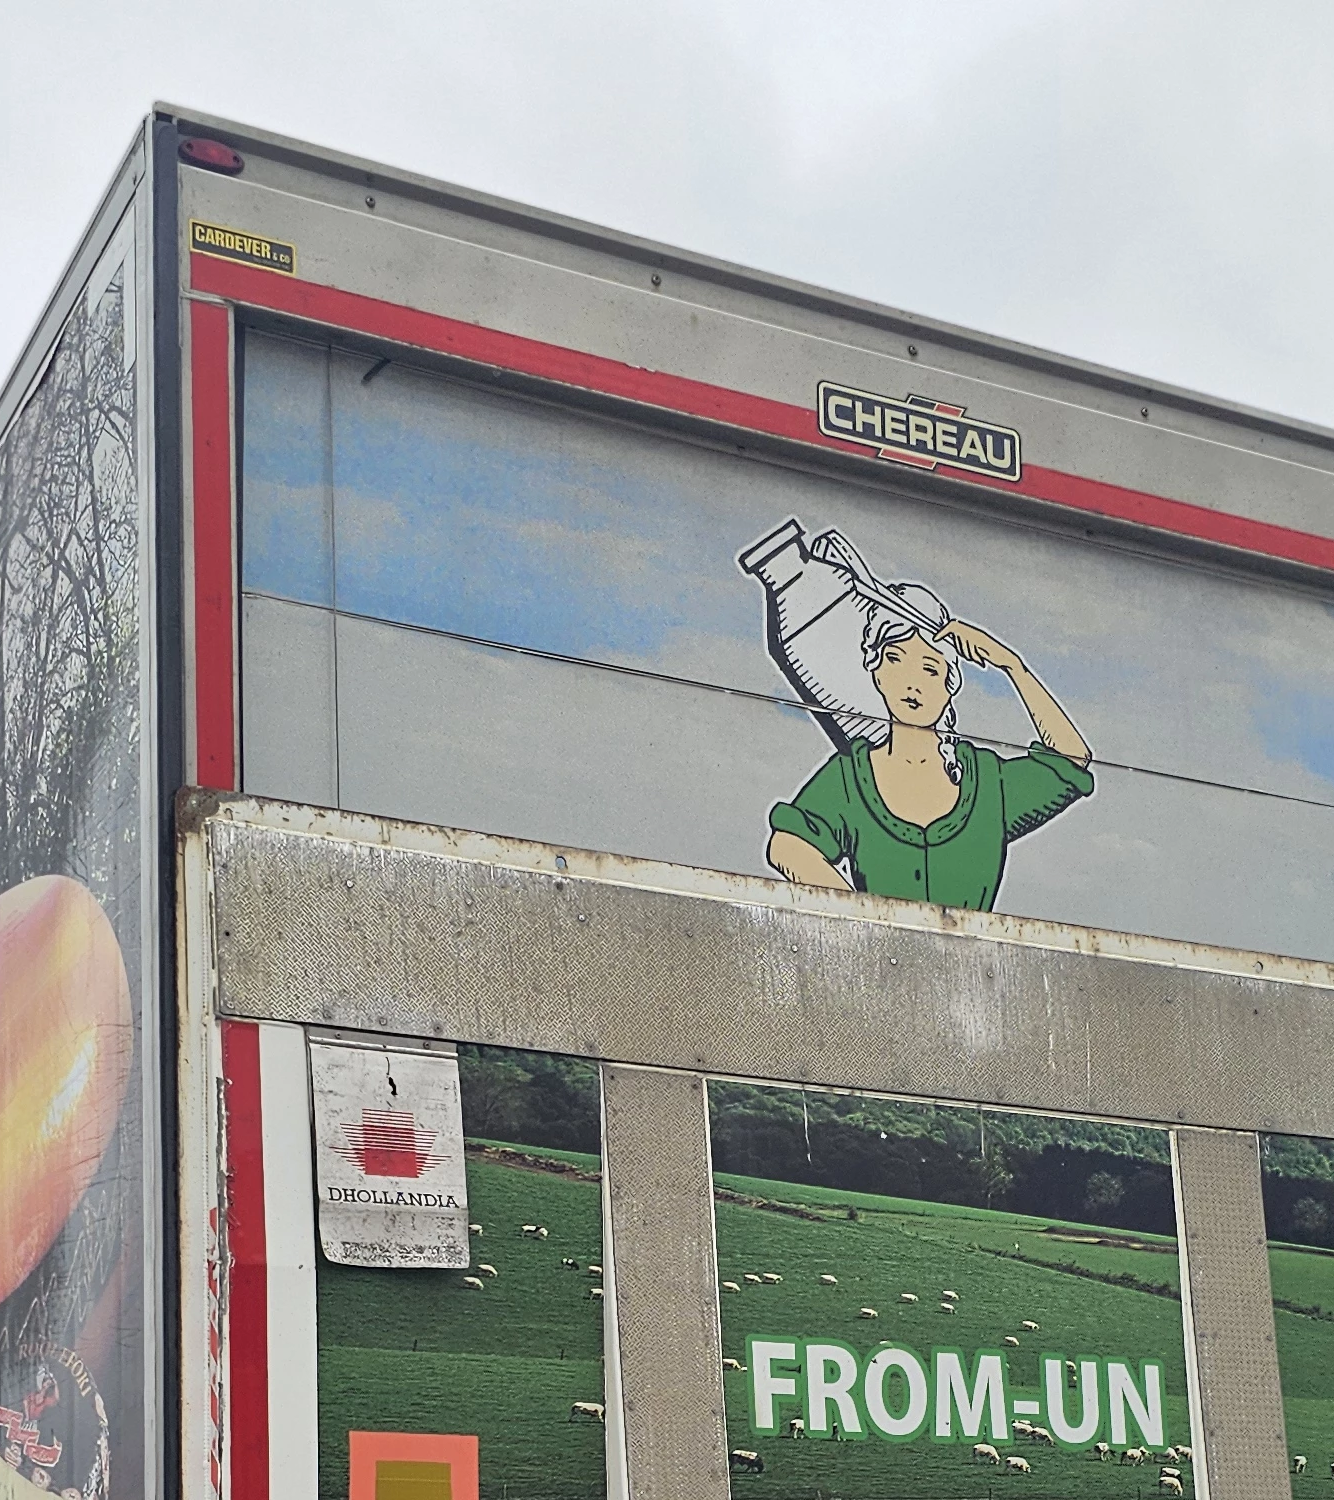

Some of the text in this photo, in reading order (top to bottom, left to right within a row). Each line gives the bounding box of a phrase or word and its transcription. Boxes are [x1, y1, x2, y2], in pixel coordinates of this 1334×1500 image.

[195, 225, 271, 259] CARDEVER
[827, 395, 1011, 469] CHEREAU
[327, 1186, 460, 1208] DHOLLANDIA
[751, 1340, 1163, 1447] FROM-UN
